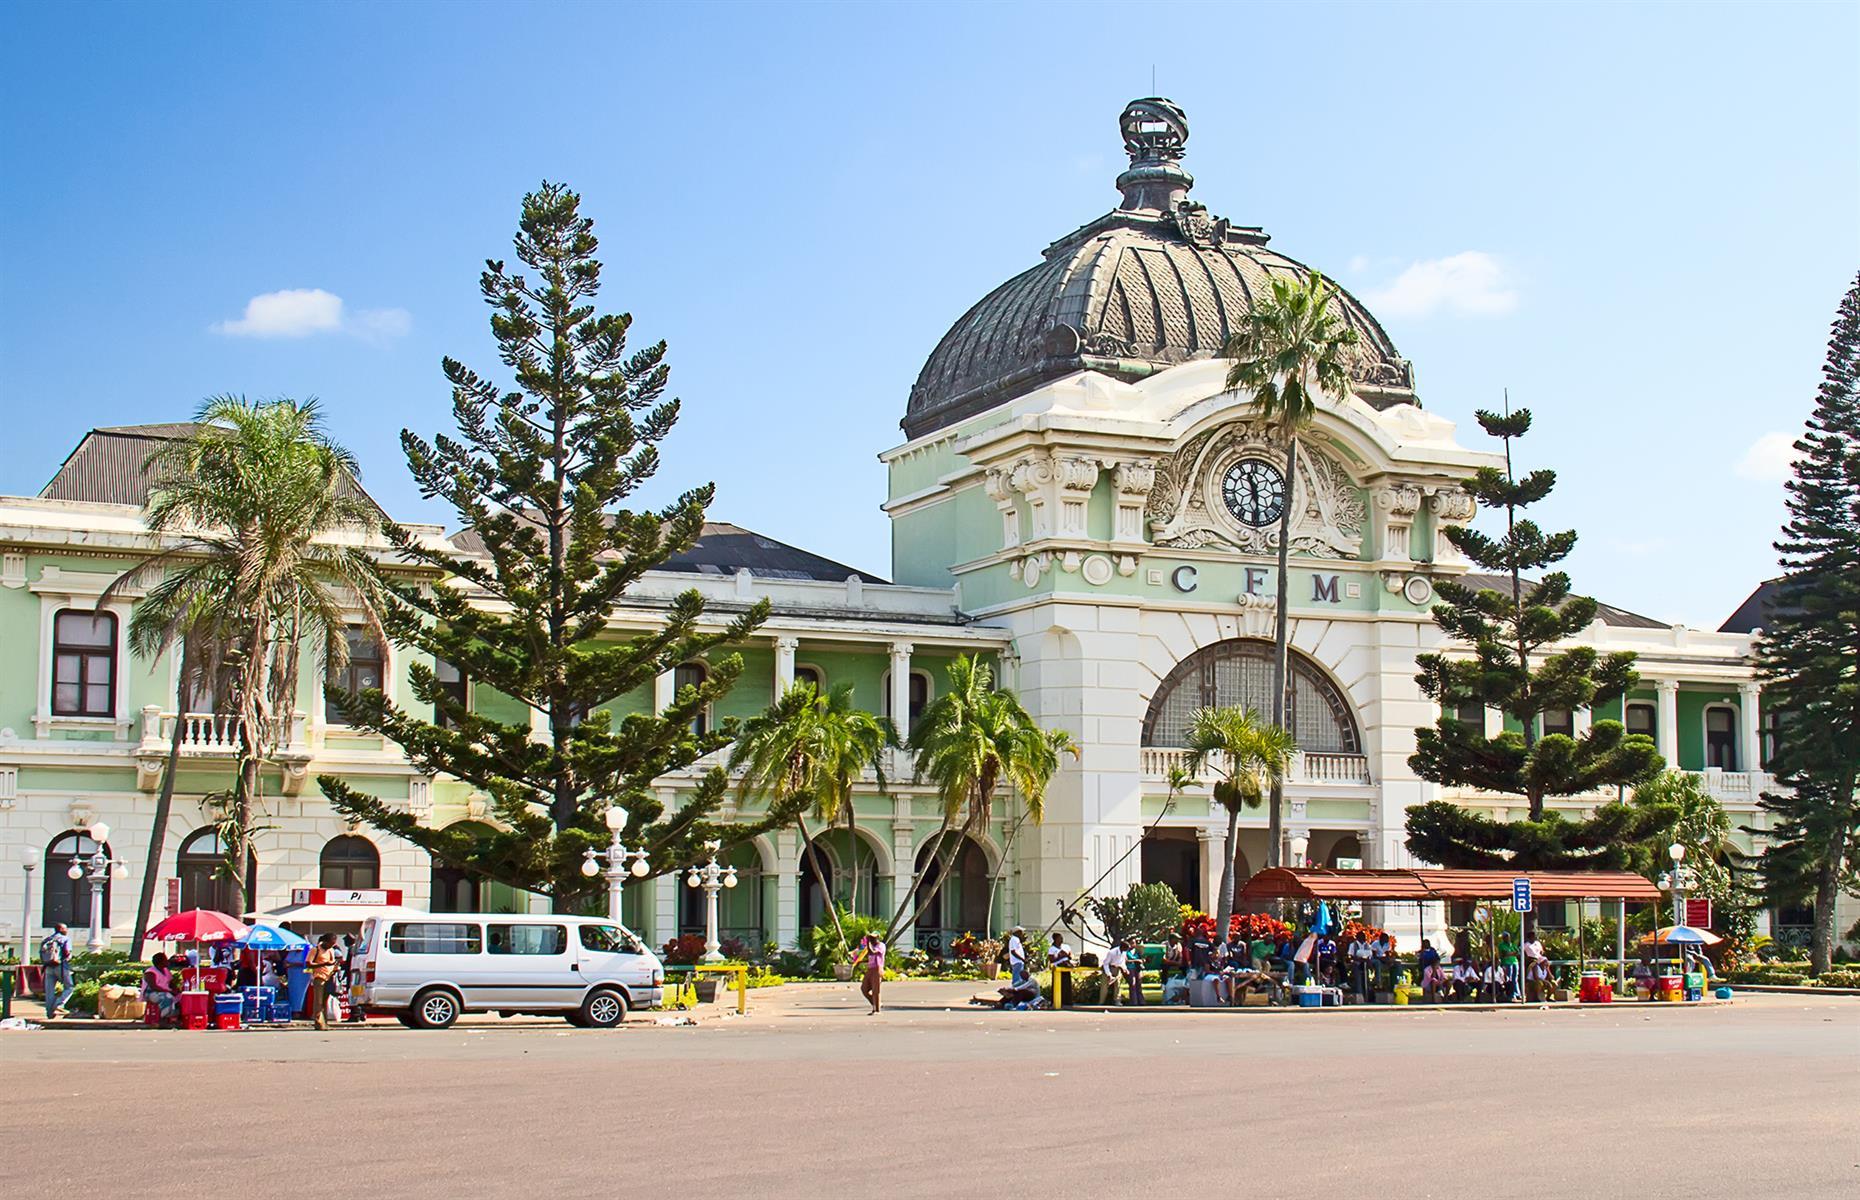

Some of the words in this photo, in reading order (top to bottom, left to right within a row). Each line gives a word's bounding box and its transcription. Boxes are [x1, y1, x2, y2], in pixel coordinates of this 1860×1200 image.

[1171, 565, 1197, 593] C
[1243, 567, 1269, 595] F
[1311, 574, 1342, 603] M
[1517, 898, 1527, 910] R
